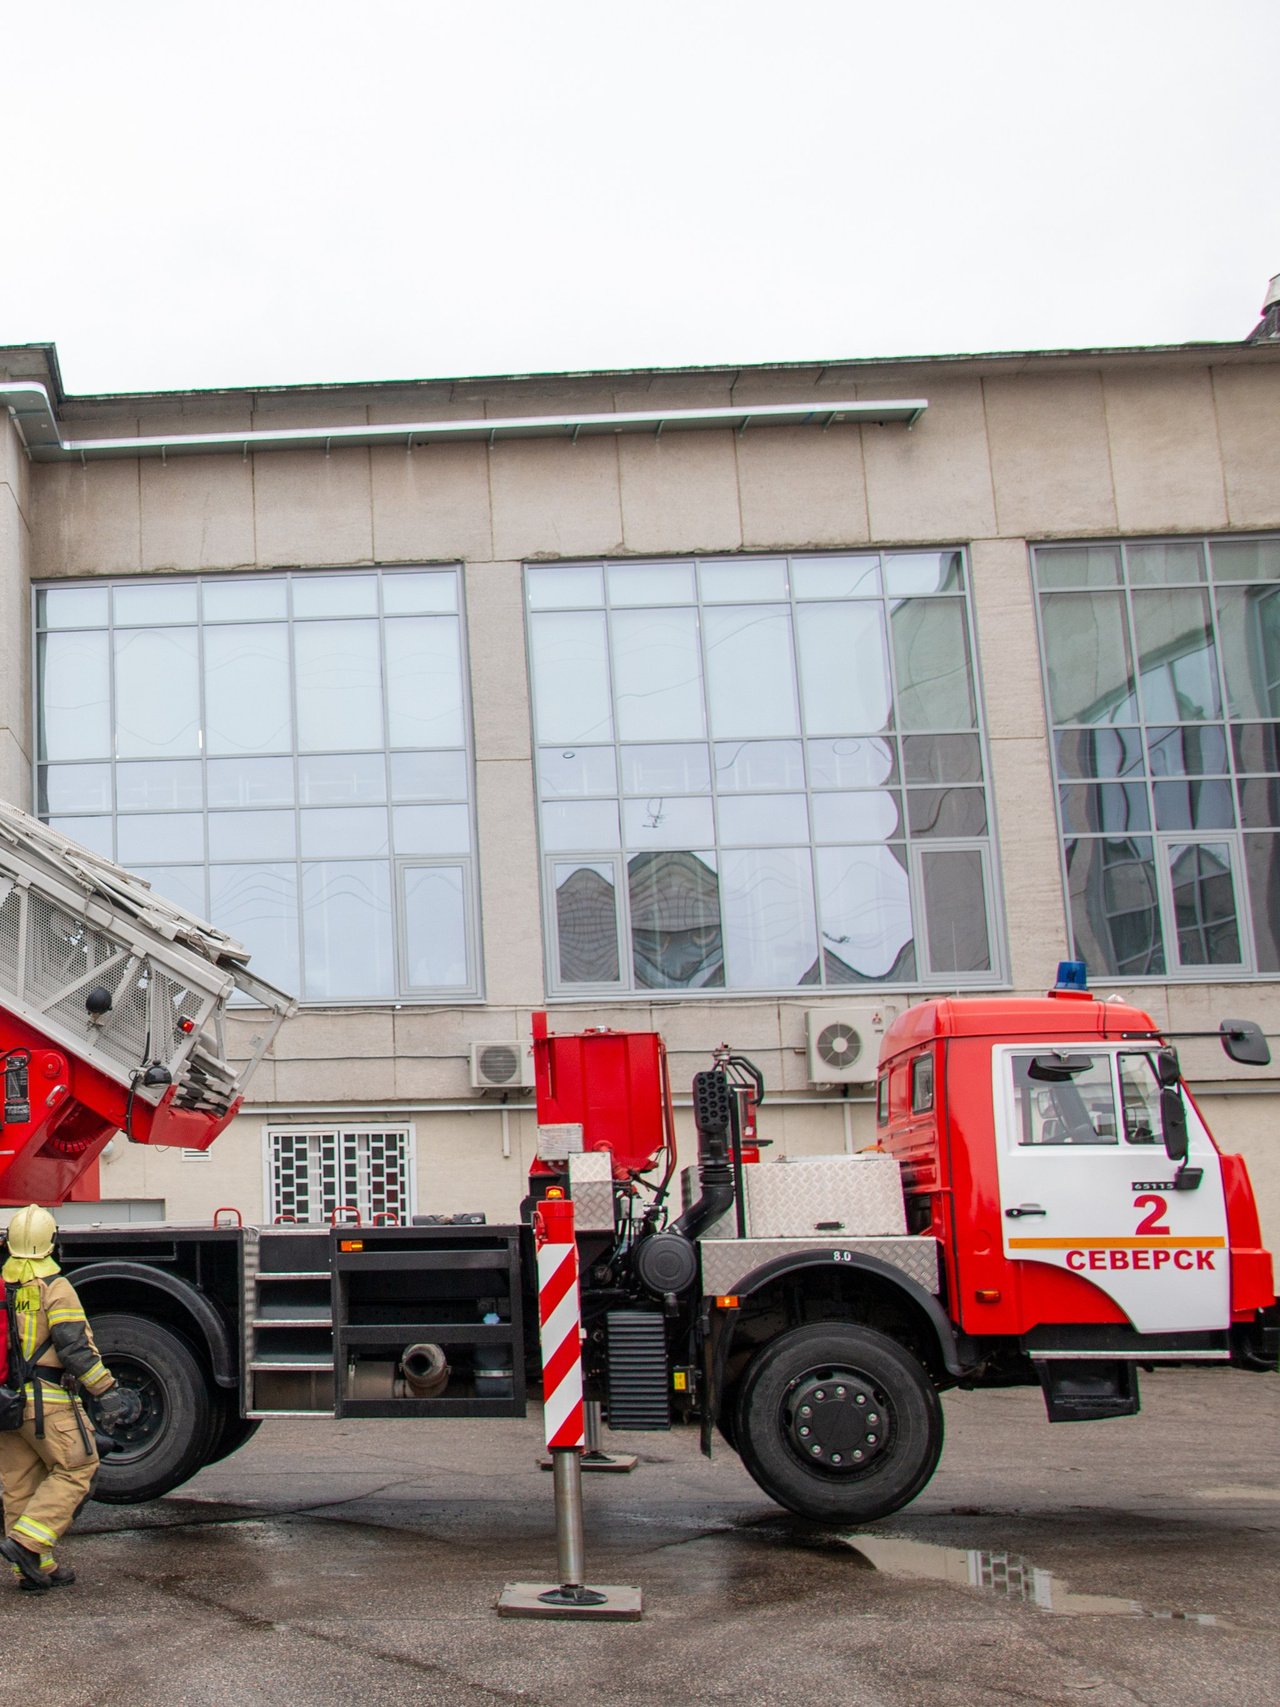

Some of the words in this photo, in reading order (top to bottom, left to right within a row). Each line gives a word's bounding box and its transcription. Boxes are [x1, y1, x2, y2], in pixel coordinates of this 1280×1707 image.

[1133, 1194, 1170, 1235] 2
[833, 1251, 852, 1261] 8.0
[1066, 1250, 1215, 1270] СЕВЕРСК
